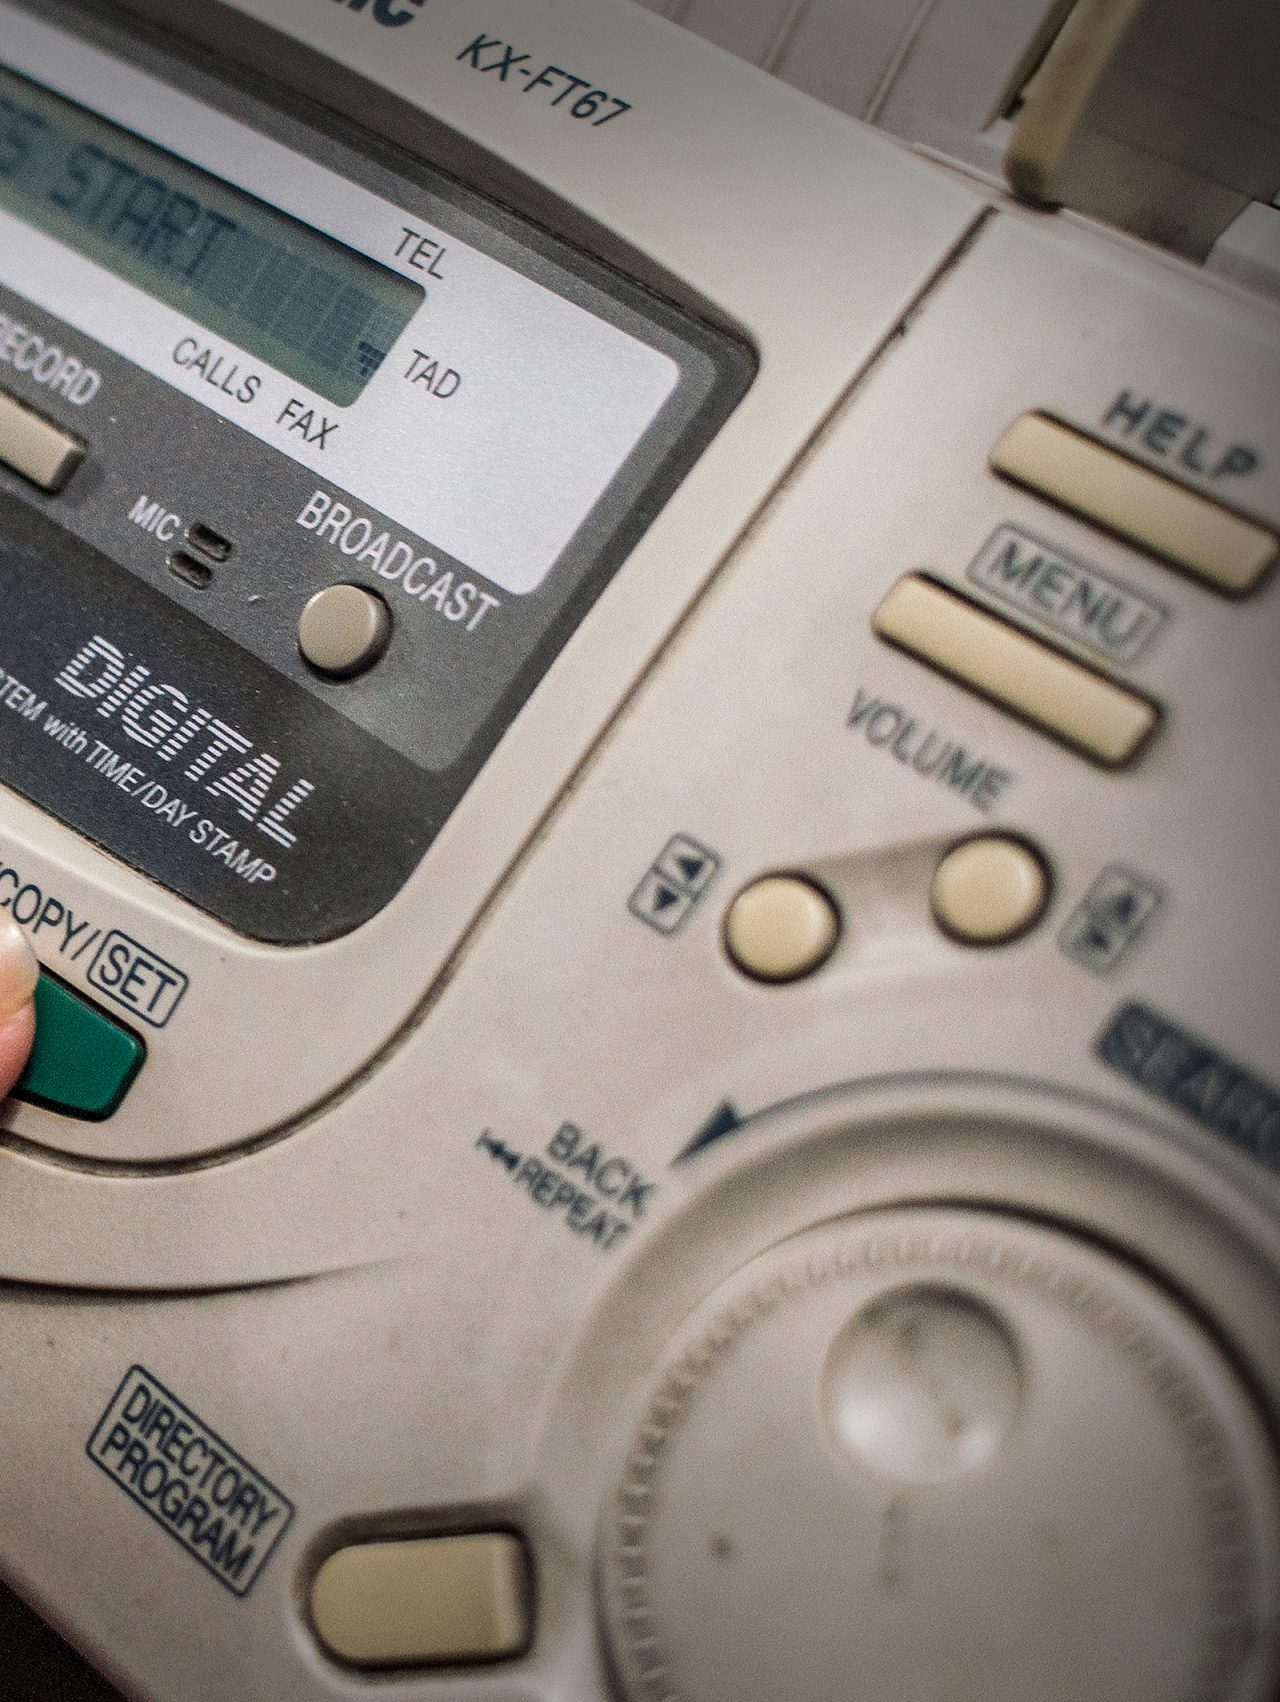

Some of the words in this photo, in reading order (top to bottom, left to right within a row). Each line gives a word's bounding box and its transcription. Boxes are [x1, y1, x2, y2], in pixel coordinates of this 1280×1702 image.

[455, 33, 633, 127] KX-FT67
[49, 141, 240, 278] START
[393, 226, 446, 281] TEL
[171, 335, 262, 405] CALLS
[402, 349, 462, 401] TAD
[275, 397, 339, 452] FAX
[1101, 388, 1260, 481] HELP
[127, 494, 182, 543] MIC
[295, 489, 501, 632] BROADCAST
[986, 540, 1147, 651] MENU
[54, 634, 316, 849] DIGITAL
[844, 685, 1016, 815] VOLUME
[42, 713, 88, 756] with
[85, 739, 199, 828] TIME/DAY
[188, 818, 278, 884] STAMP
[516, 1157, 632, 1250] REPEAT
[545, 1120, 657, 1220] BACK
[99, 1422, 255, 1580] PROGRAM
[120, 1382, 280, 1538] DIRECTORY
